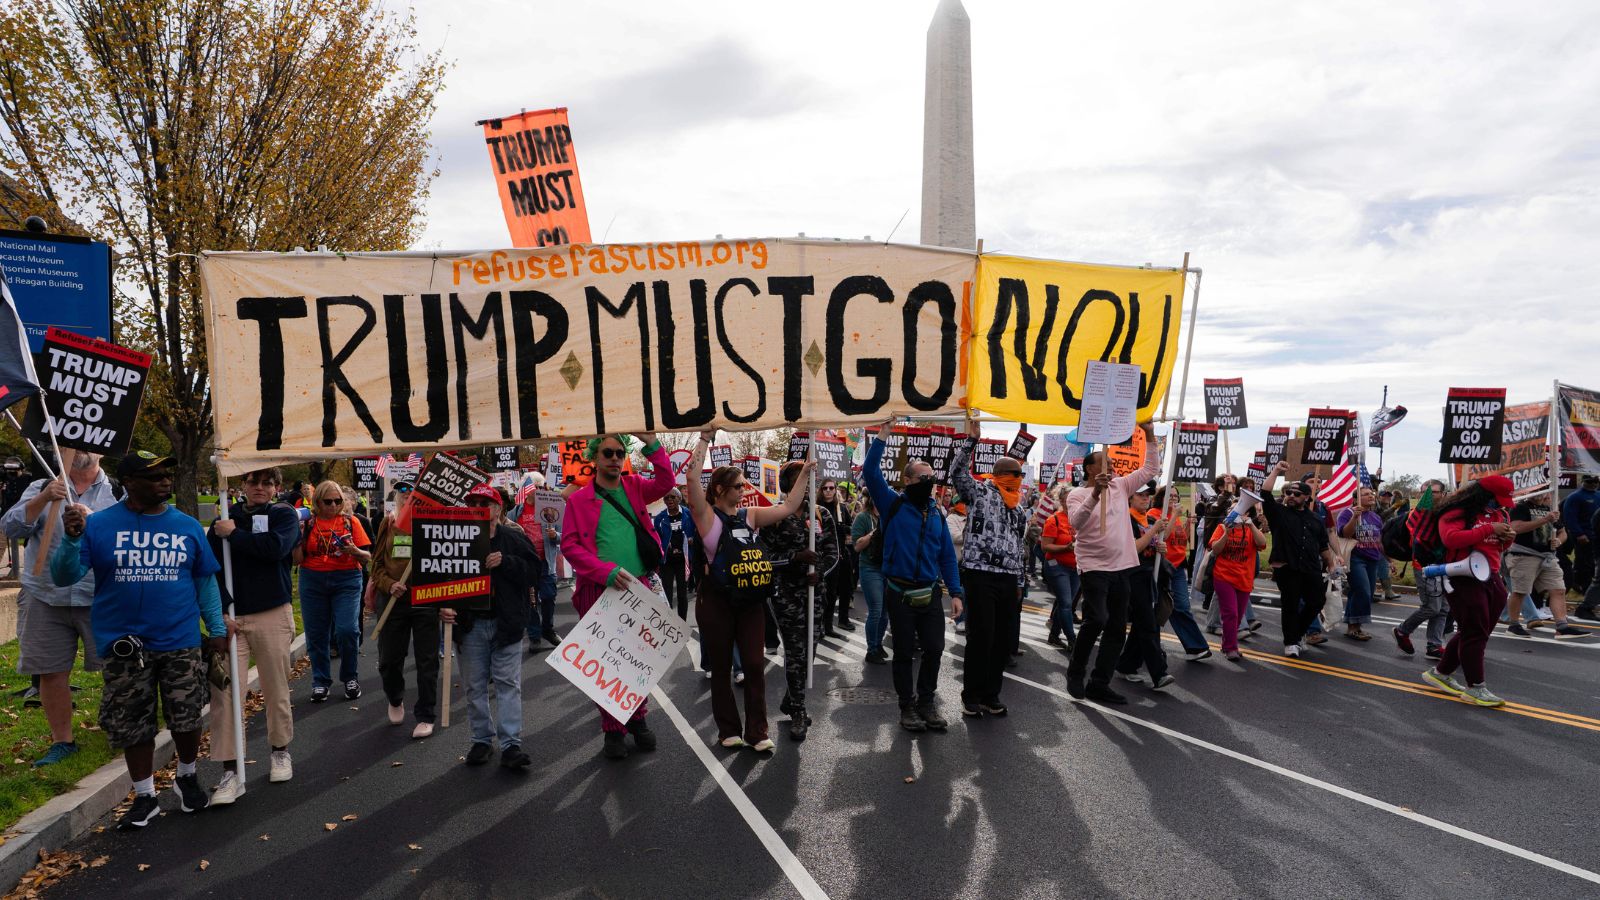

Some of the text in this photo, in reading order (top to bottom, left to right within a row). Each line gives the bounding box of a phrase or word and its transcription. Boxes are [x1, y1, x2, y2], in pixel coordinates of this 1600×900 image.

[486, 124, 572, 174] TRUMP
[508, 169, 576, 217] MUST
[0, 241, 56, 253] National Mall
[27, 255, 64, 265] Museum
[452, 240, 768, 286] refusefascism.org
[38, 267, 79, 278] Museums
[15, 276, 47, 287] Reagan
[48, 279, 84, 290] Building
[54, 329, 144, 362] RefuseFascism.org
[48, 347, 141, 387] TRUMP
[236, 289, 569, 451] TRUMP
[585, 275, 814, 433] MUST
[50, 371, 128, 406] MUST
[1206, 386, 1241, 396] TRUMP
[1210, 396, 1238, 406] MUST
[63, 398, 103, 423] GO
[1218, 407, 1232, 416] GO
[1449, 401, 1501, 414] TRUMP
[1214, 416, 1240, 426] NOW!
[1309, 418, 1344, 429] TRUMP
[1452, 416, 1494, 429] MUST
[41, 415, 117, 448] NOW!
[1310, 429, 1339, 439] MUST
[1502, 418, 1542, 443] ASCIST
[867, 434, 905, 446] TMP
[931, 435, 952, 447] TRUMP
[1267, 434, 1287, 444] TRUMP
[1460, 431, 1480, 444] GO
[815, 442, 845, 452] TRUMP
[994, 445, 1004, 453] SE
[1178, 444, 1210, 455] MUST
[1268, 445, 1283, 454] MUST
[1315, 440, 1329, 450] GO
[818, 452, 843, 461] MUST
[881, 447, 901, 457] UST
[931, 447, 949, 458] MUST
[1308, 451, 1336, 460] NOW!
[1450, 445, 1491, 458] NOW!
[826, 461, 839, 469] GO
[934, 459, 943, 469] GO
[1185, 456, 1202, 467] GO
[1270, 455, 1278, 463] GO
[823, 469, 847, 478] NOW!
[976, 464, 994, 473] TRUM
[1178, 467, 1209, 479] NOW!
[441, 467, 473, 489] Nov 5
[882, 470, 901, 482] OW!
[423, 472, 462, 496] FLOOD
[422, 524, 480, 540] TRUMP
[116, 531, 188, 551] FUCK
[431, 541, 471, 557] DOIT
[741, 549, 763, 560] STOP
[114, 549, 187, 567] TRUMP
[135, 567, 161, 575] FUCK
[420, 558, 480, 574] PARTIR
[731, 560, 773, 575] GENOCID
[752, 573, 772, 587] GAZ
[619, 589, 644, 613] THE
[619, 613, 636, 628] ON
[601, 651, 623, 672] FOR
[608, 637, 654, 676] CROWNS
[561, 642, 644, 715] CLOWNS!
